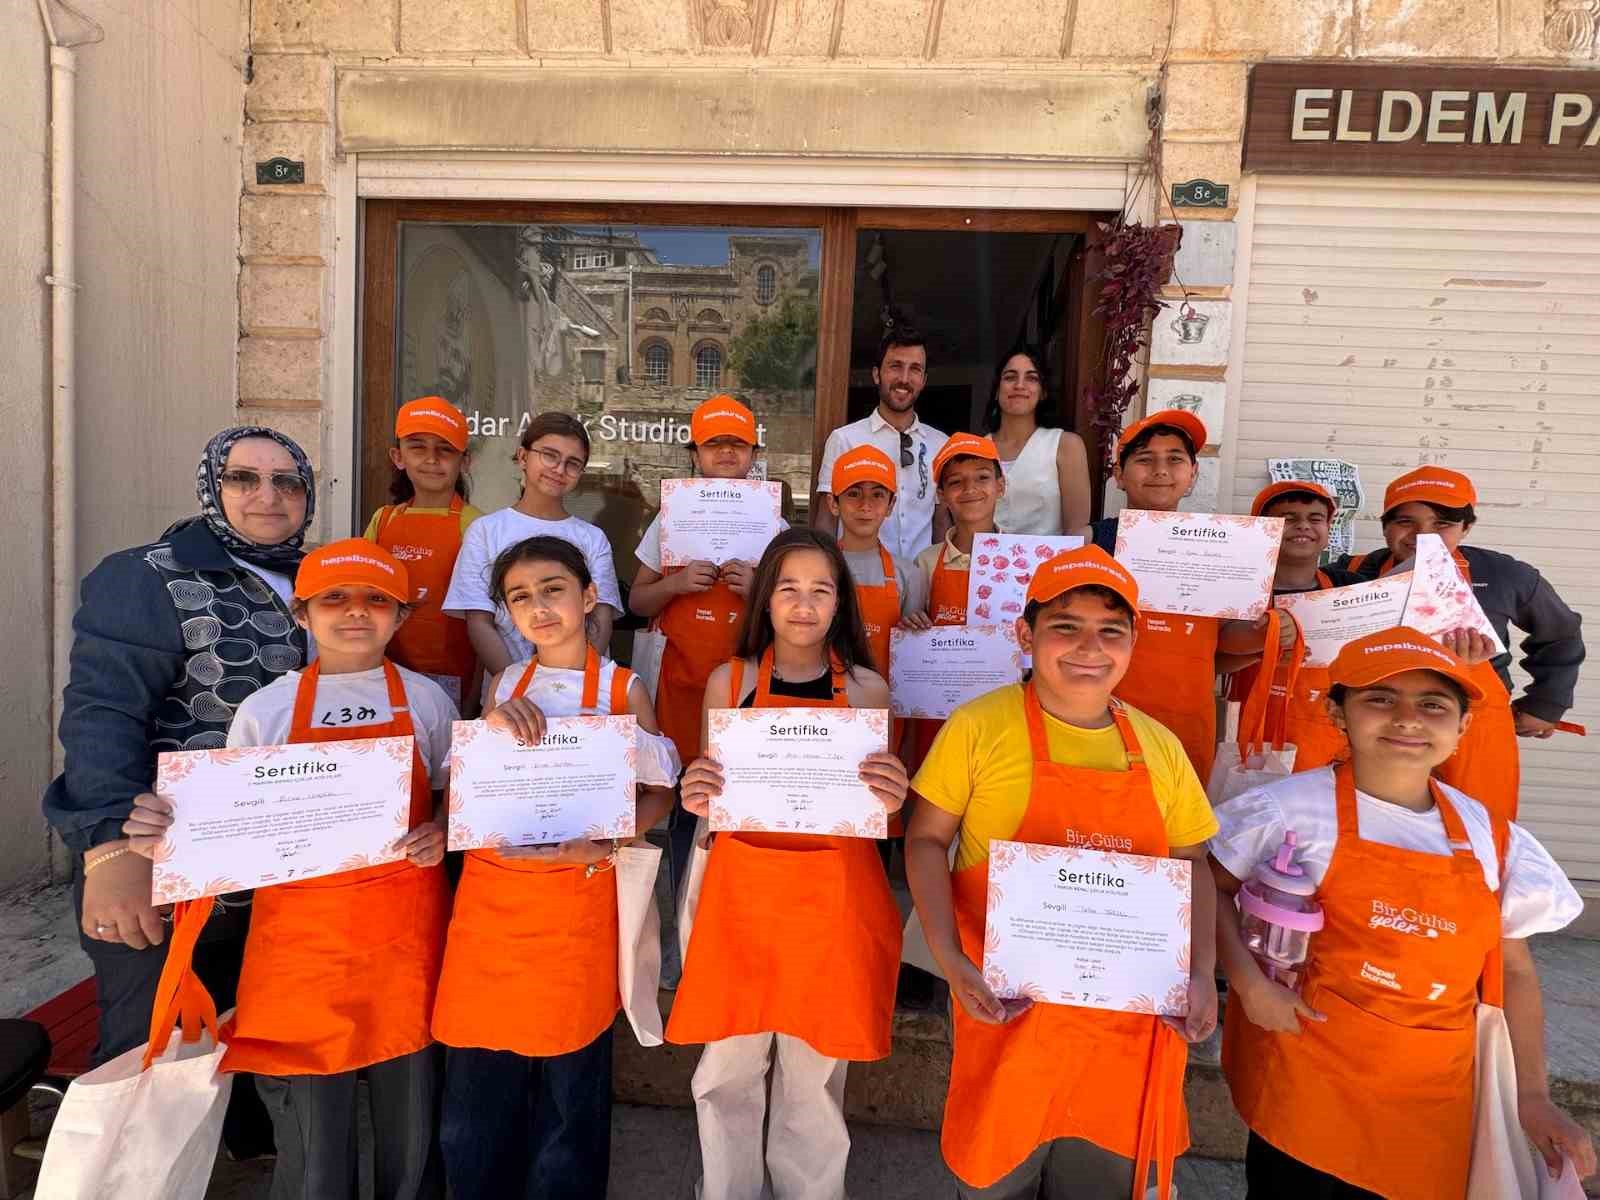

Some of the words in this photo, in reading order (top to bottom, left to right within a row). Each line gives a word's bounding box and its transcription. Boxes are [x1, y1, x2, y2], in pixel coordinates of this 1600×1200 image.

[1291, 88, 1528, 144] ELDEM
[466, 410, 510, 437] dar
[600, 415, 692, 444] Studio
[699, 489, 742, 499] Sertifika
[1171, 526, 1227, 540] Sertifika
[417, 587, 429, 600] 7
[1332, 590, 1390, 609] Sertifika
[728, 612, 738, 624] 7
[1185, 622, 1195, 635] 7
[930, 638, 975, 647] Sertifika
[769, 724, 829, 737] Sertifika
[516, 733, 579, 747] Stifika
[254, 761, 338, 779] Sertifika
[287, 869, 296, 878] 7
[1058, 868, 1125, 889] Sertifika
[1042, 901, 1067, 913] Sevgili
[1371, 899, 1399, 916] Bir
[1426, 981, 1447, 1001] 7
